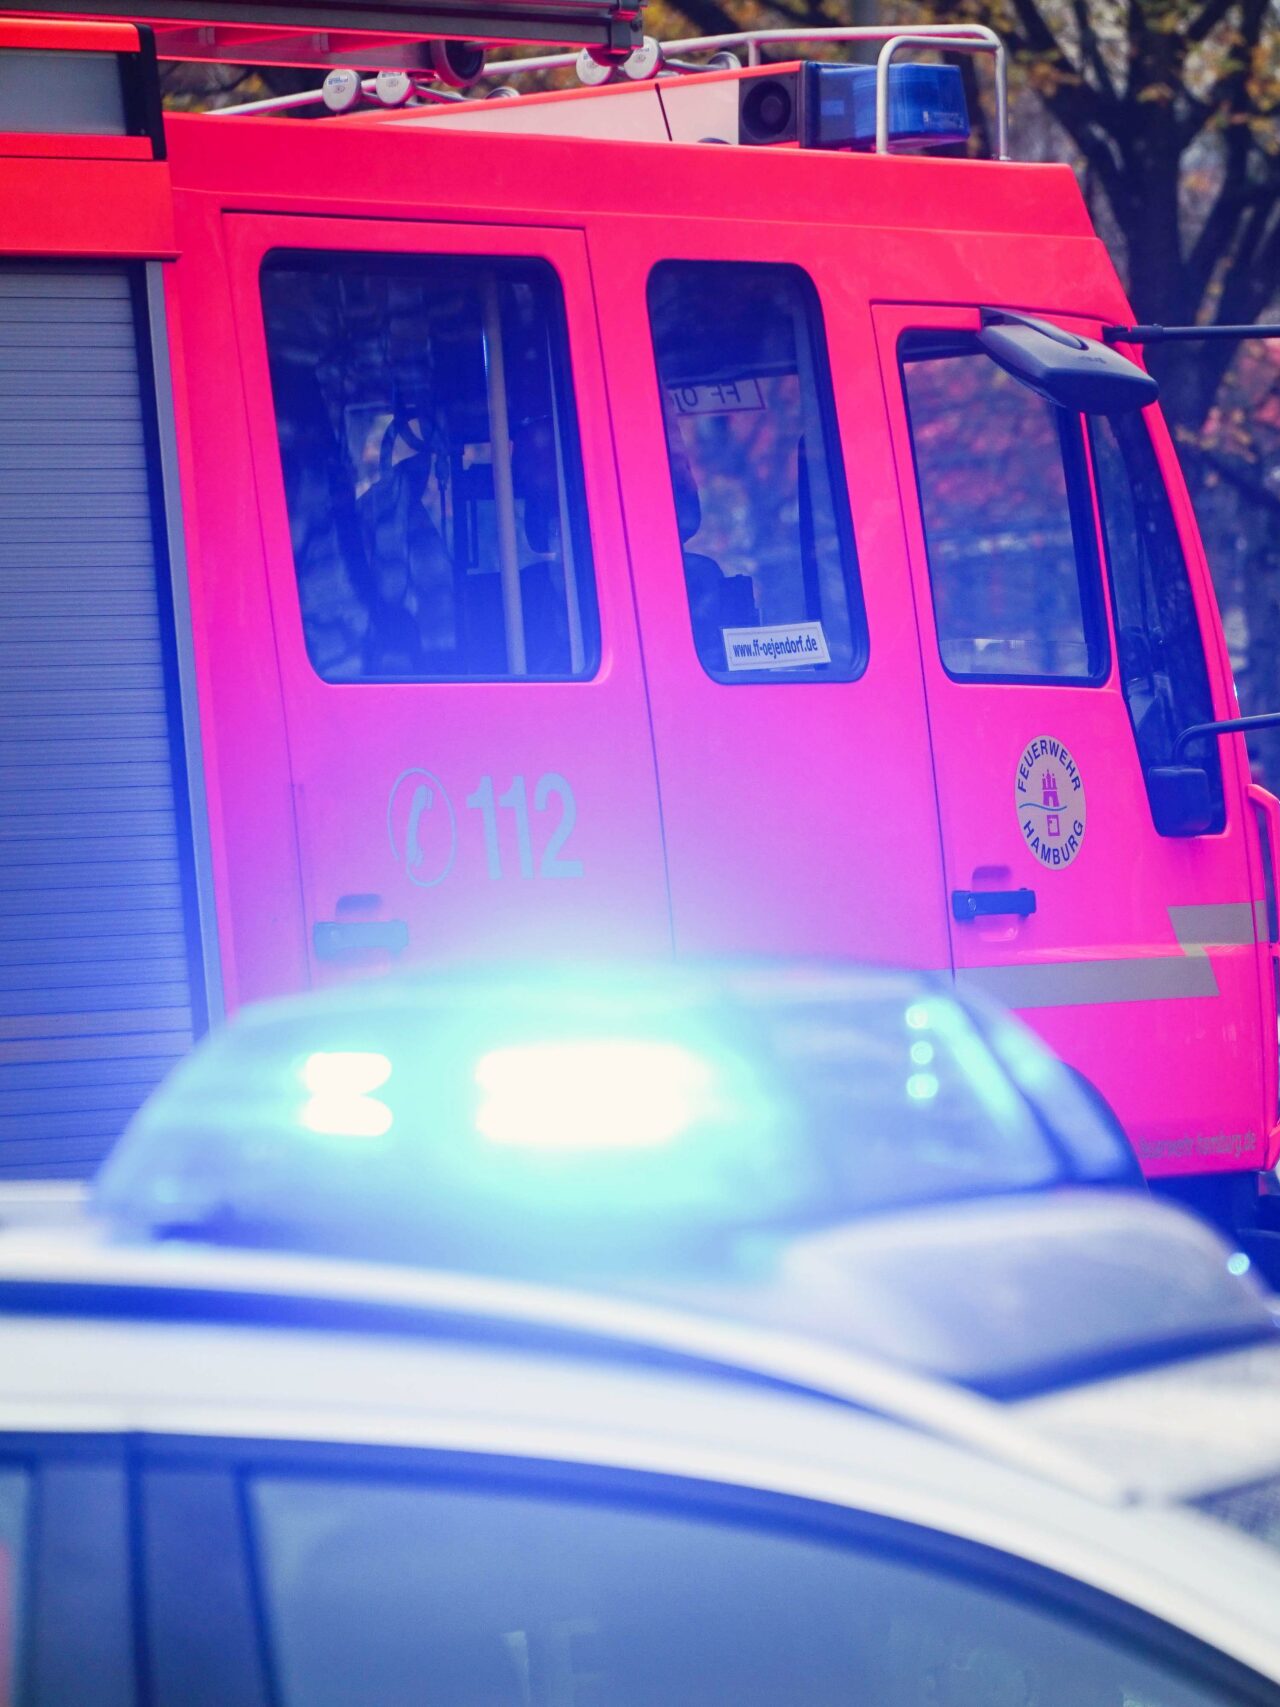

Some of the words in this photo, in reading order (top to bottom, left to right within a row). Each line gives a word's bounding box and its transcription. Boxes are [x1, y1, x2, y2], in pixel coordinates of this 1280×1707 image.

[732, 634, 819, 660] www.ff-oejendorf.de
[1017, 738, 1082, 793] FEUERWEHR
[466, 771, 585, 881] 112
[1023, 820, 1084, 865] HAMBURG
